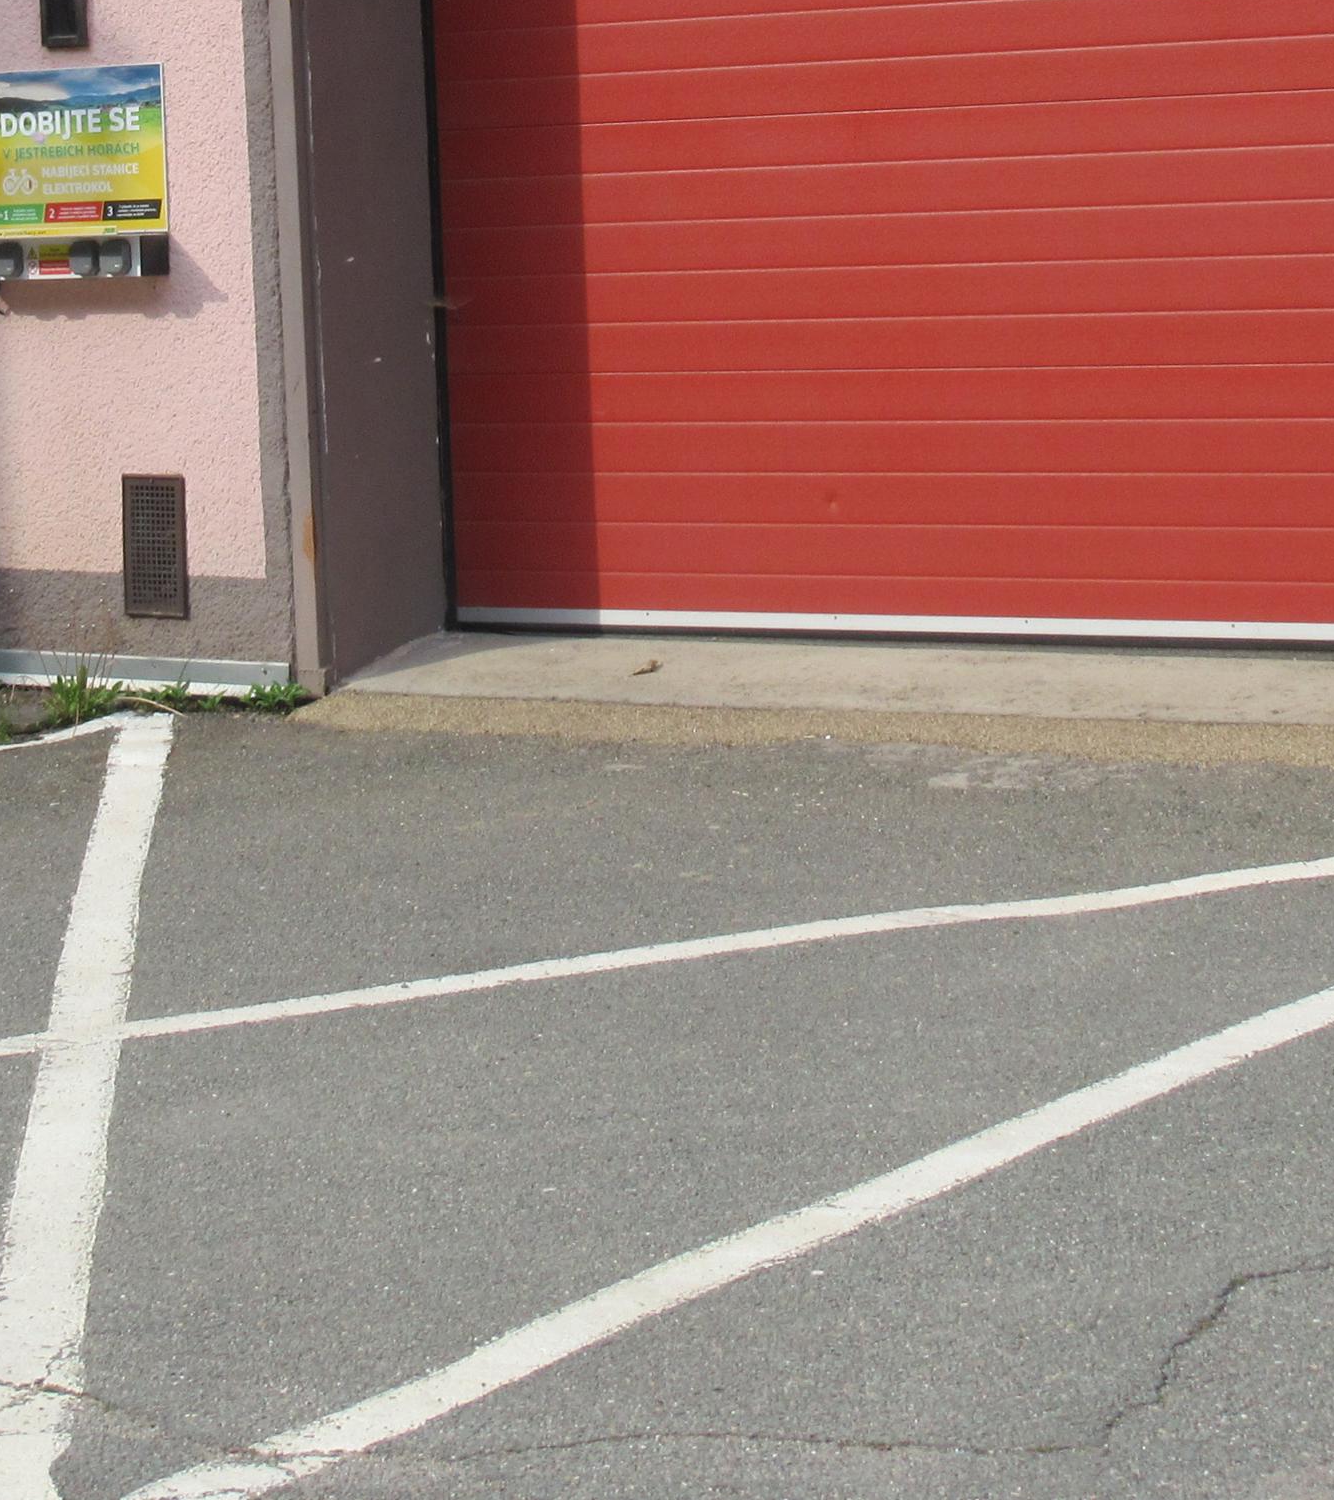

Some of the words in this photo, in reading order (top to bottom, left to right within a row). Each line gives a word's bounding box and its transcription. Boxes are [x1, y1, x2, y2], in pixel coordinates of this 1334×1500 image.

[0, 108, 102, 140] DOBIJTE
[109, 106, 140, 132] SE
[2, 147, 11, 159] V
[92, 163, 139, 176] STANICE
[4, 210, 9, 220] 1
[49, 208, 55, 219] 2
[107, 206, 113, 217] 3
